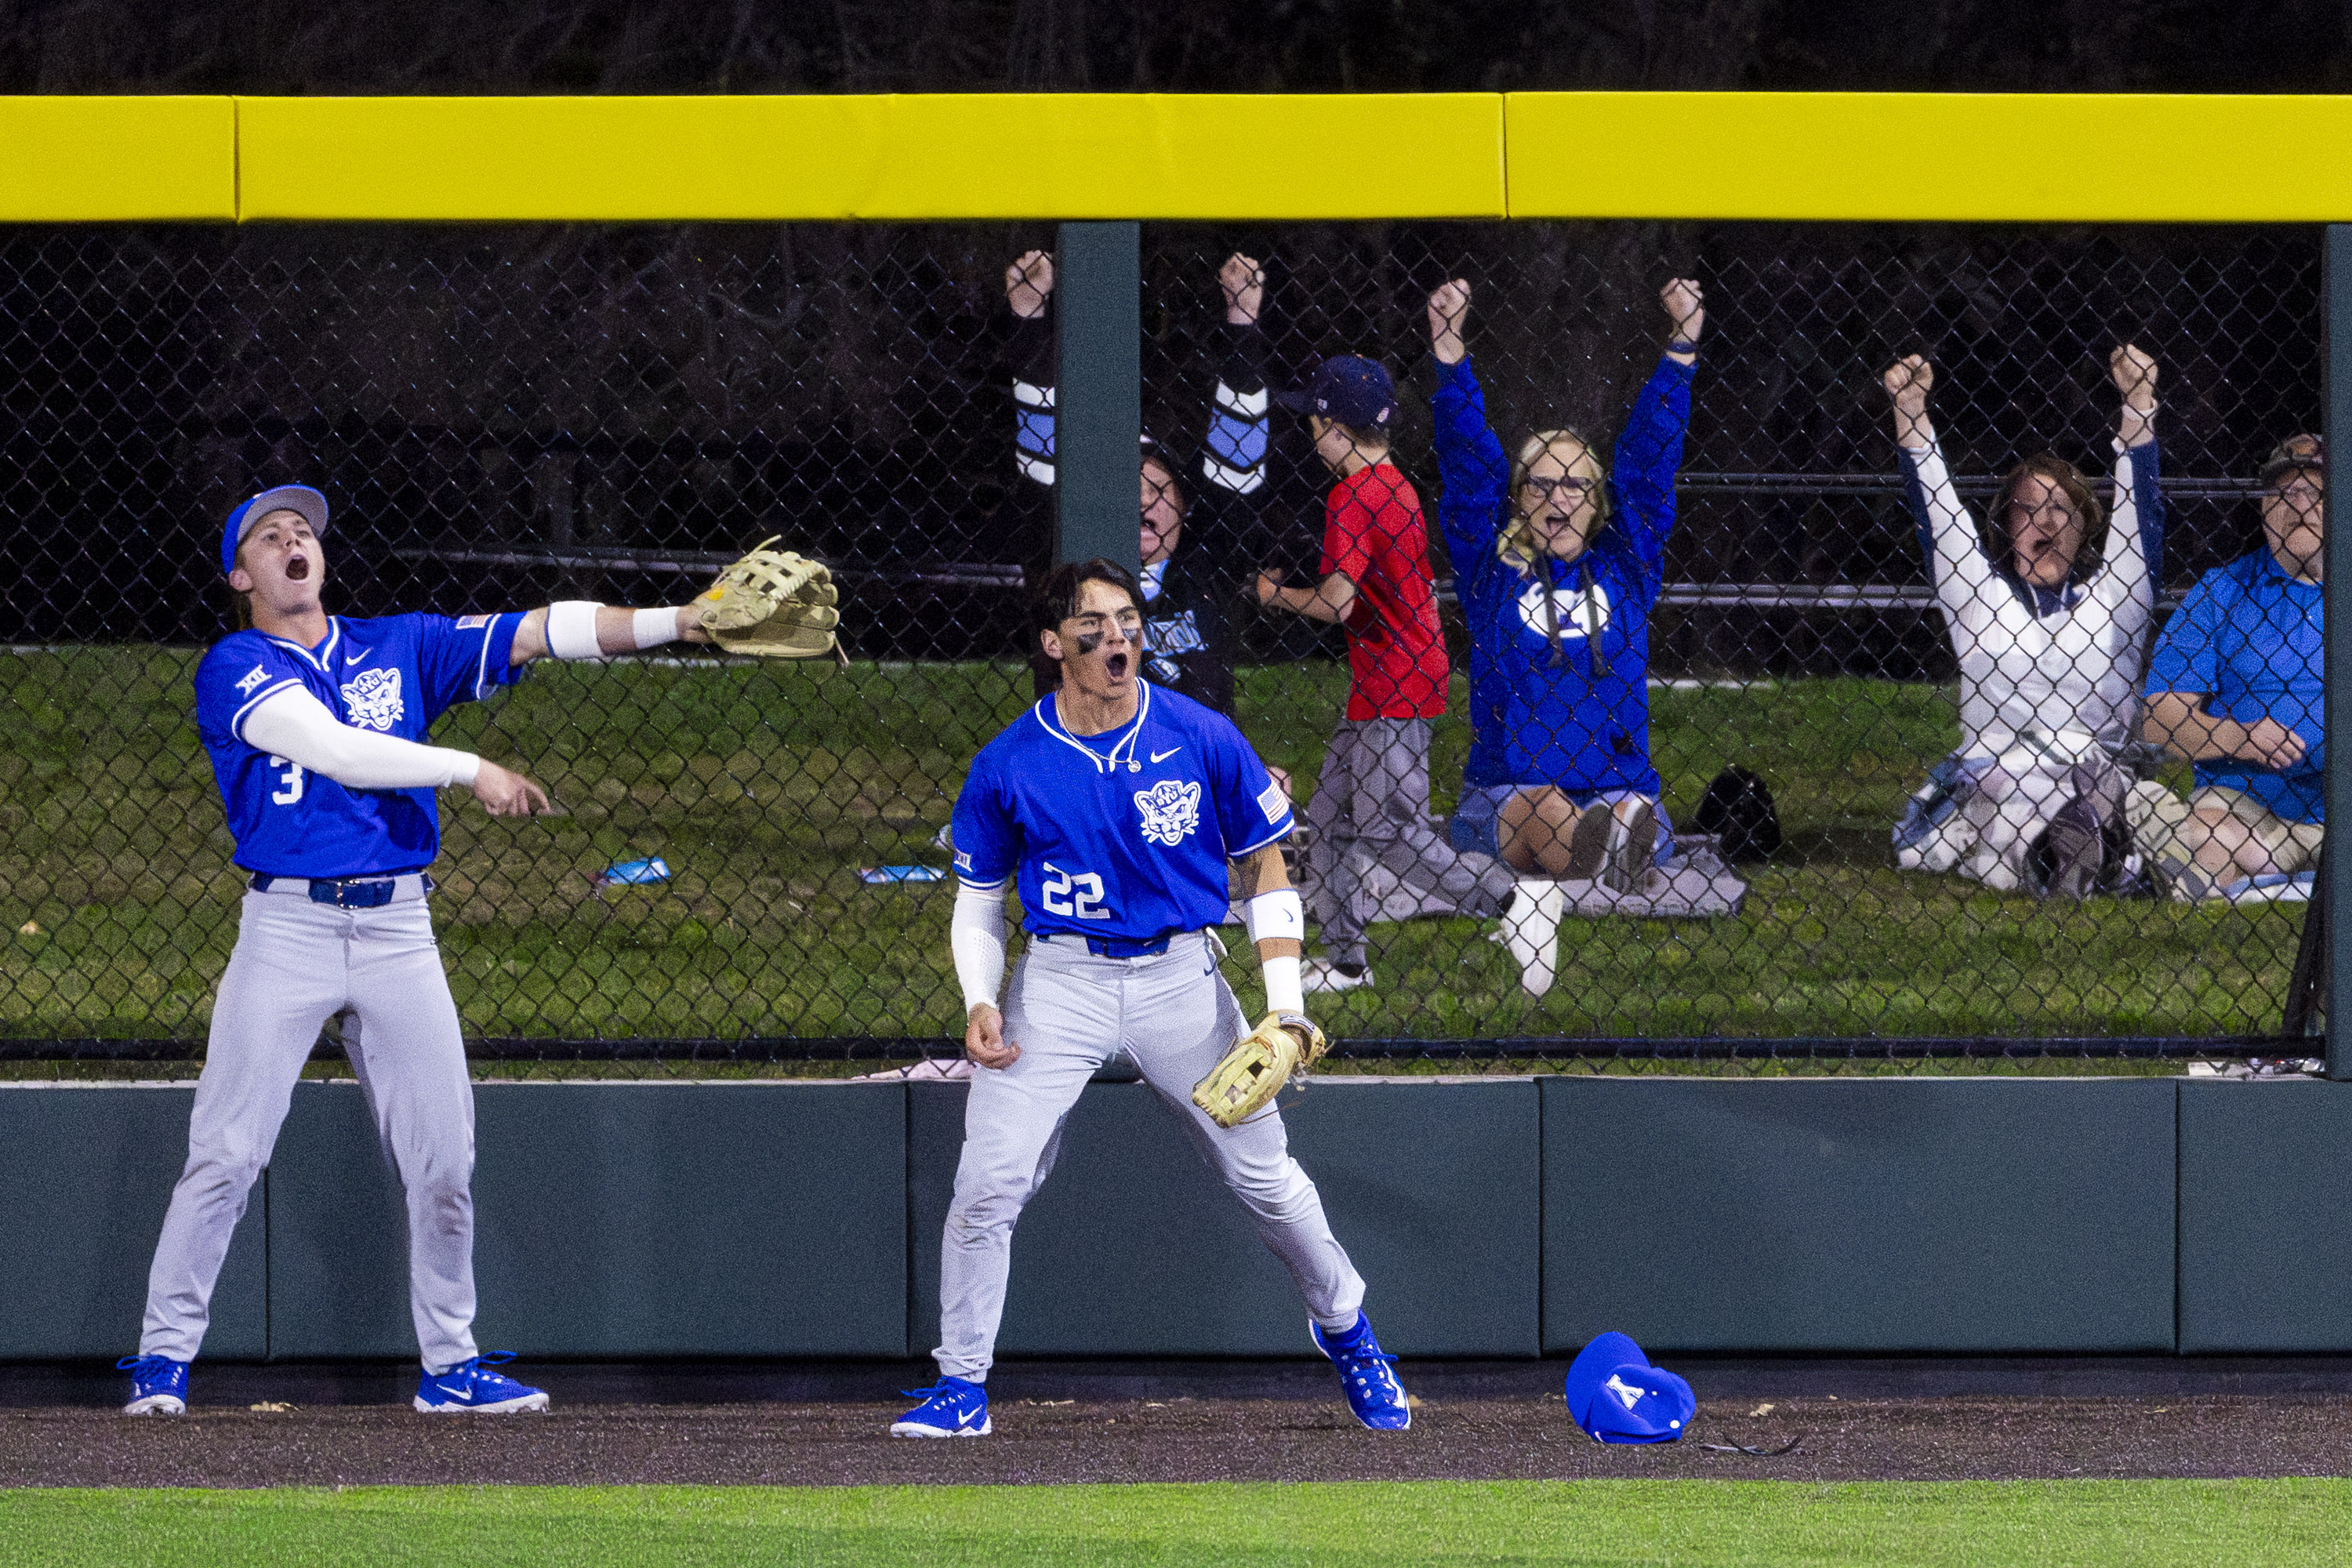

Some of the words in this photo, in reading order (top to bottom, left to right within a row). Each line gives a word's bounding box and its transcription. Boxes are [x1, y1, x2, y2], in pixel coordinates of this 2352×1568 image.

[270, 754, 303, 806] 3
[1043, 862, 1110, 919] 22
[1606, 1374, 1645, 1410] Y
